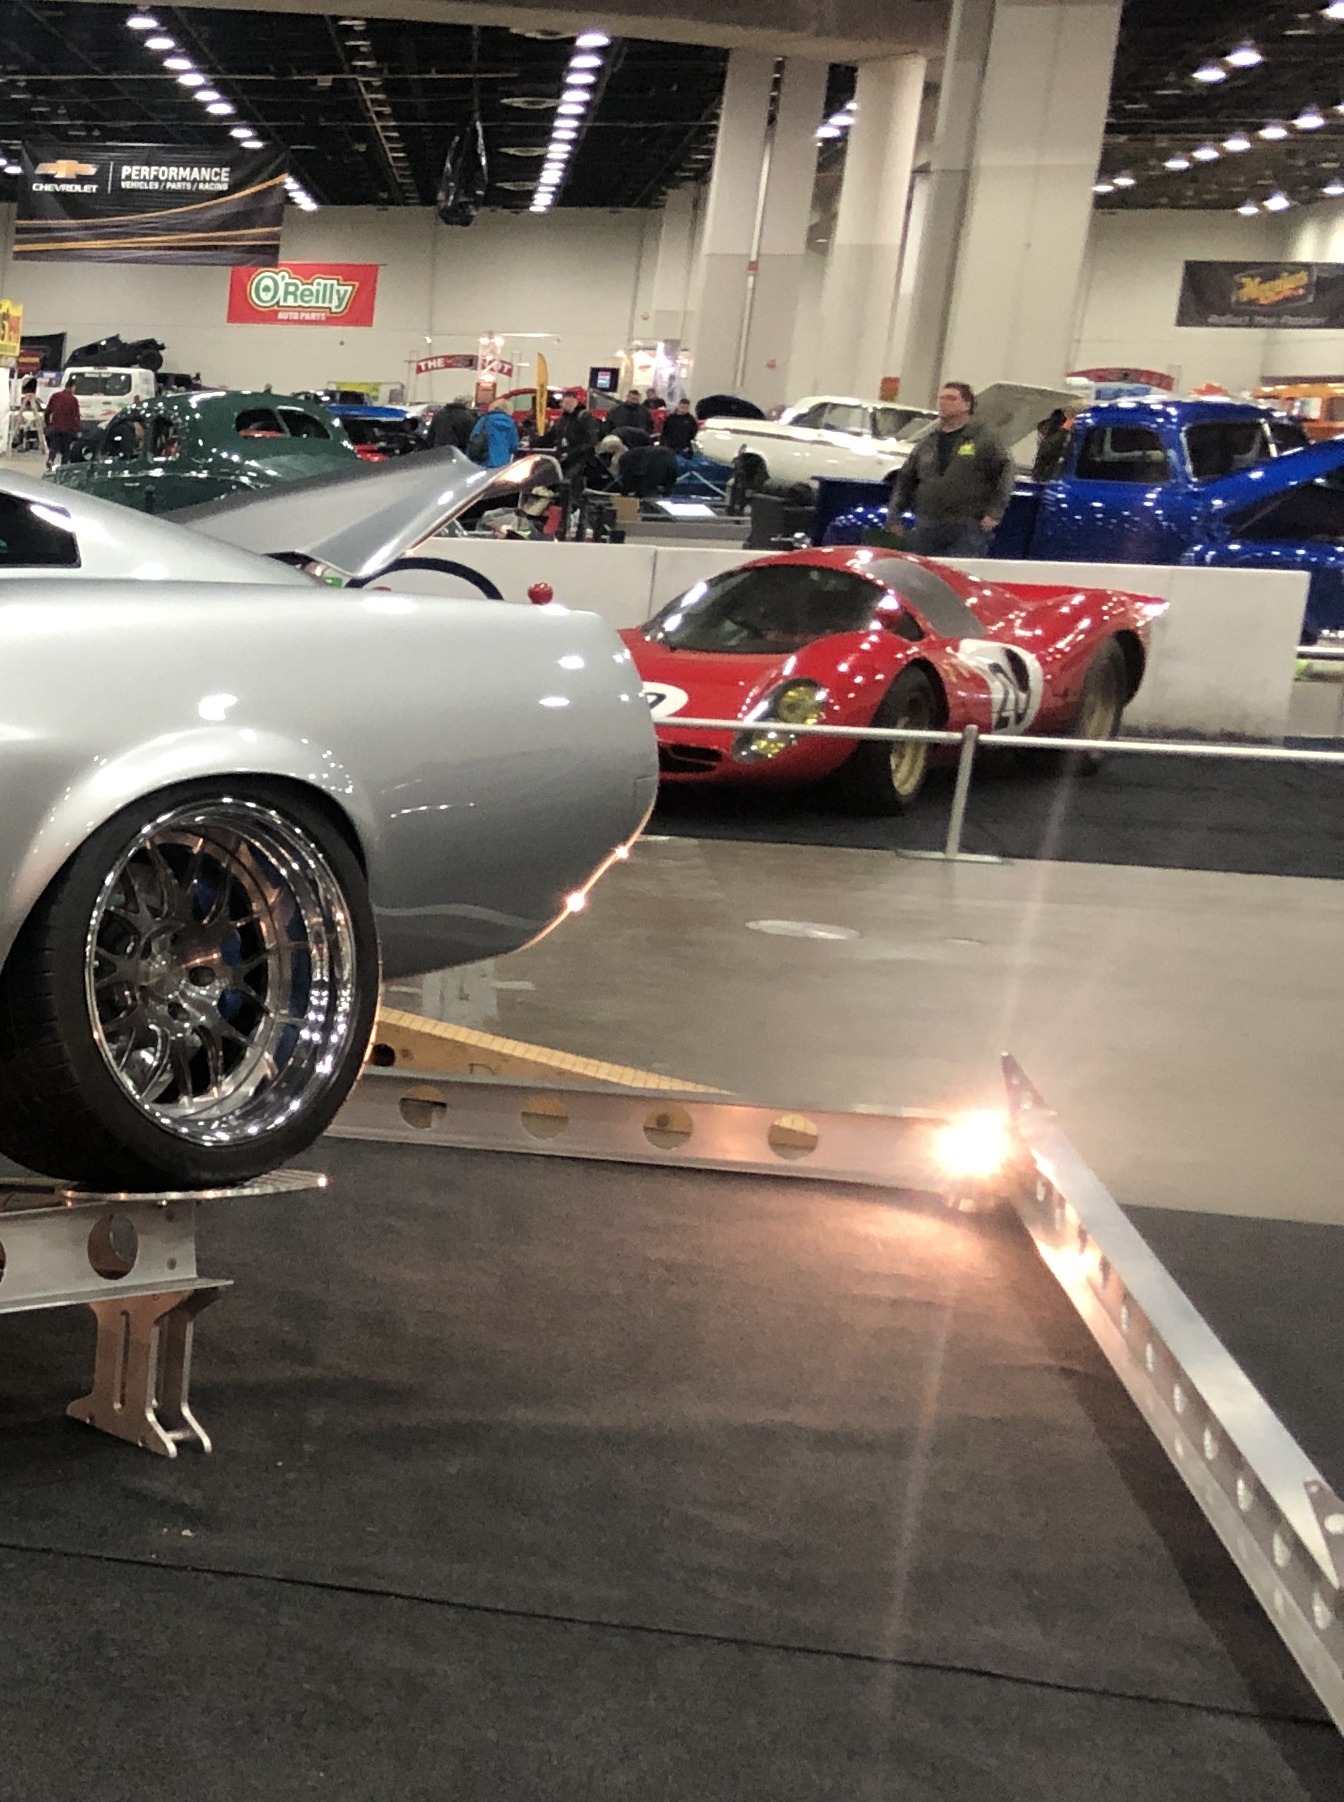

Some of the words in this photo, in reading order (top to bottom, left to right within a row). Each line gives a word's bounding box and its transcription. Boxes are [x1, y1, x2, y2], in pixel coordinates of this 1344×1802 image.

[121, 165, 231, 182] PERFORMANCE
[32, 182, 98, 193] CHEVROLET
[121, 181, 159, 190] VEHICLES
[166, 181, 191, 190] PARTS
[198, 182, 229, 191] RACING
[254, 274, 350, 309] O'Reilly
[418, 358, 445, 371] THE
